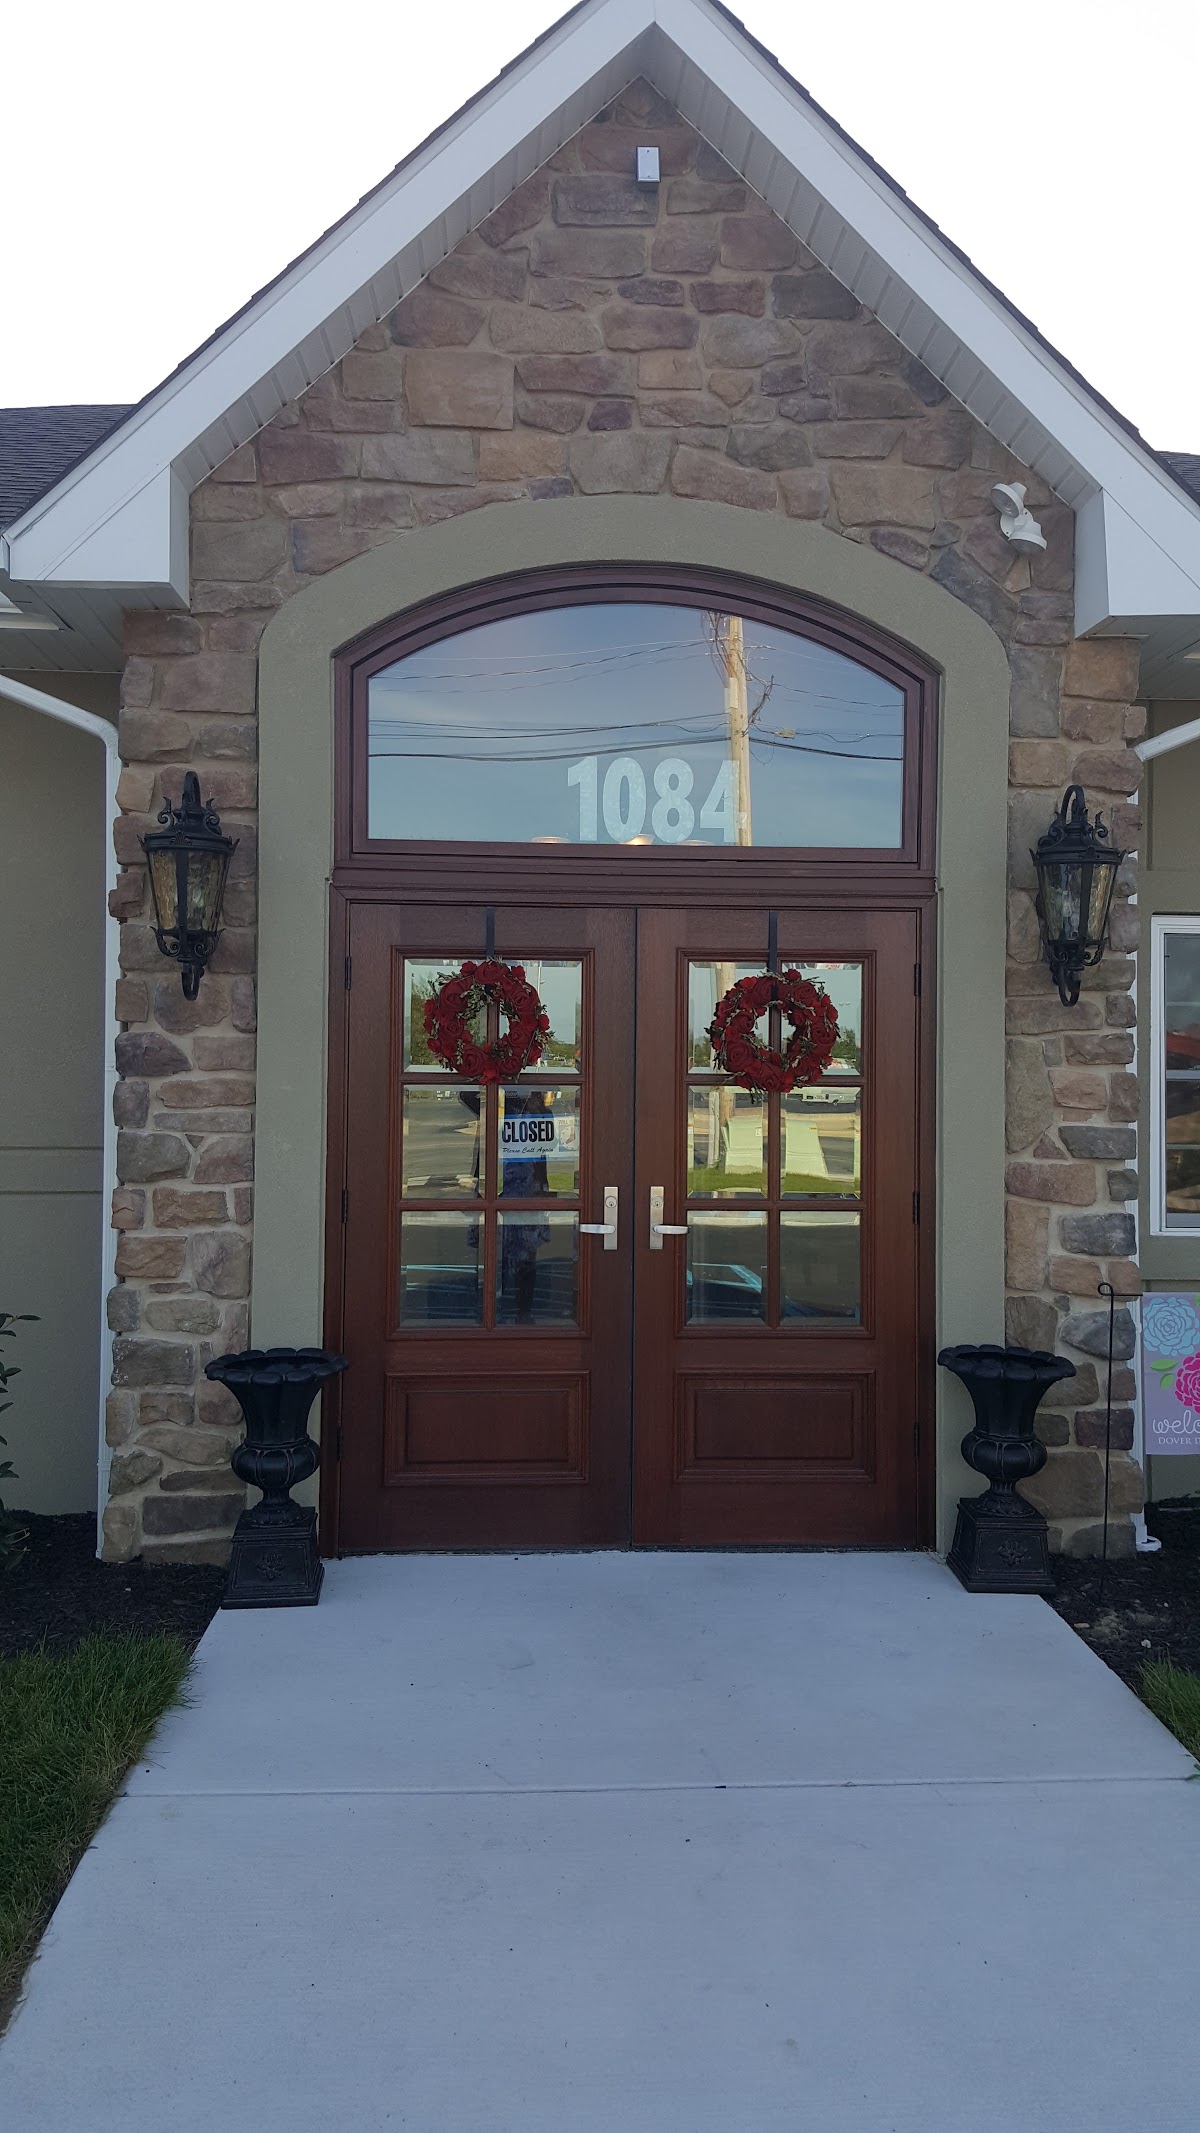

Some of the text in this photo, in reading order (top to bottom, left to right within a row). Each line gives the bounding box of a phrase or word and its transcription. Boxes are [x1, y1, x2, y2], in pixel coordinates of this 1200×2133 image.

[567, 756, 747, 843] 1084
[502, 1121, 554, 1143] CLOSED
[1158, 1436, 1192, 1445] DOVER
